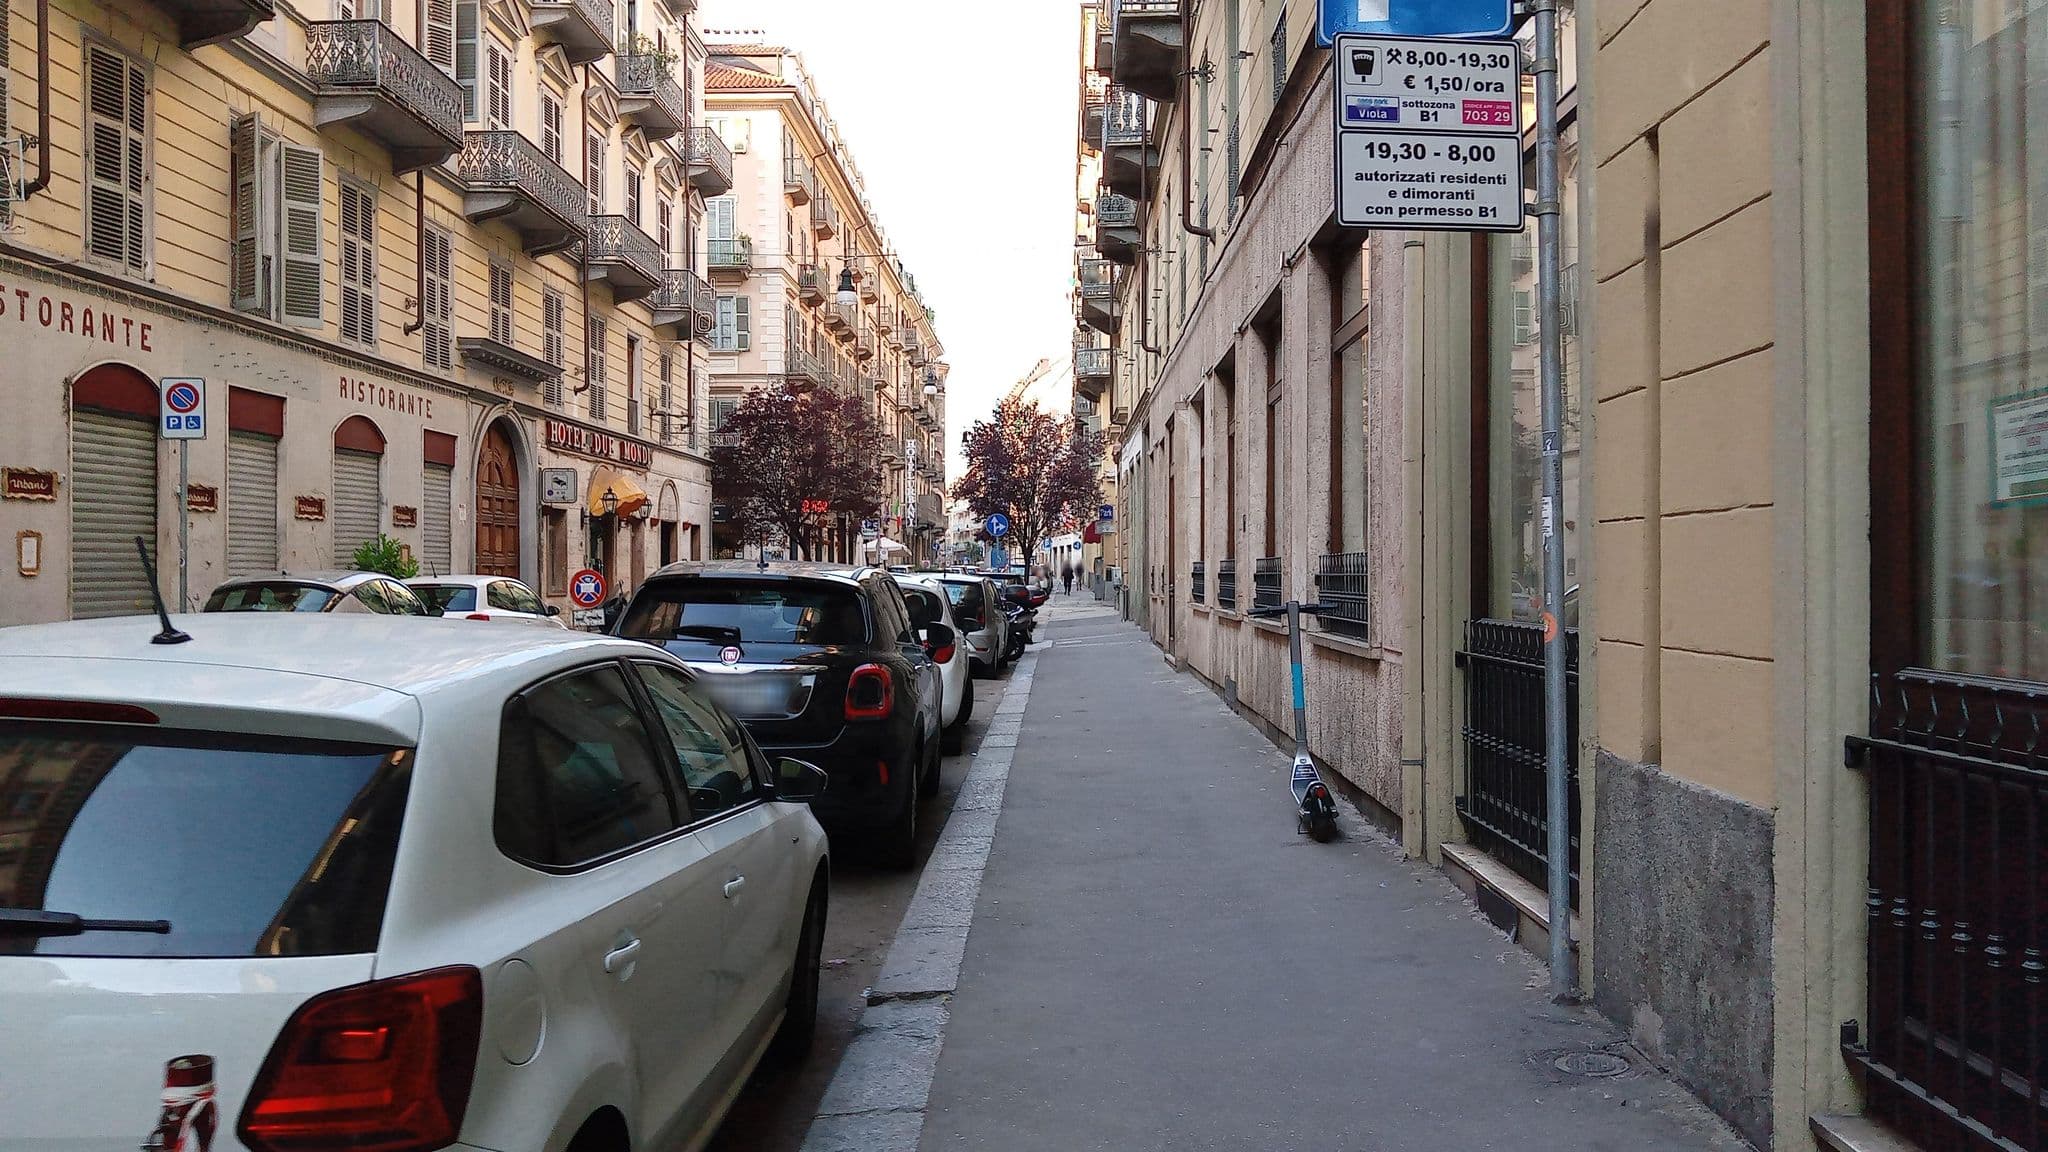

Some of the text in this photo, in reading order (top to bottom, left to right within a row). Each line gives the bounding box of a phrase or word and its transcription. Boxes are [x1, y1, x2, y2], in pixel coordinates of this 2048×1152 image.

[1403, 75, 1504, 95] € 1,50/ora
[1402, 100, 1456, 110] sottozona
[1358, 108, 1387, 119] Viola
[1420, 110, 1438, 122] B1
[1464, 110, 1510, 122] 703 29
[1364, 141, 1426, 163] 19,30
[1448, 144, 1495, 165] 8,00
[1354, 170, 1507, 185] autorizzati residenti
[1388, 187, 1475, 201] e dimoranti
[1365, 205, 1497, 218] con permesso B1
[339, 375, 432, 419] RISTORANTE
[170, 417, 179, 428] P
[550, 421, 588, 449] HOTEL
[594, 432, 617, 456] DUE
